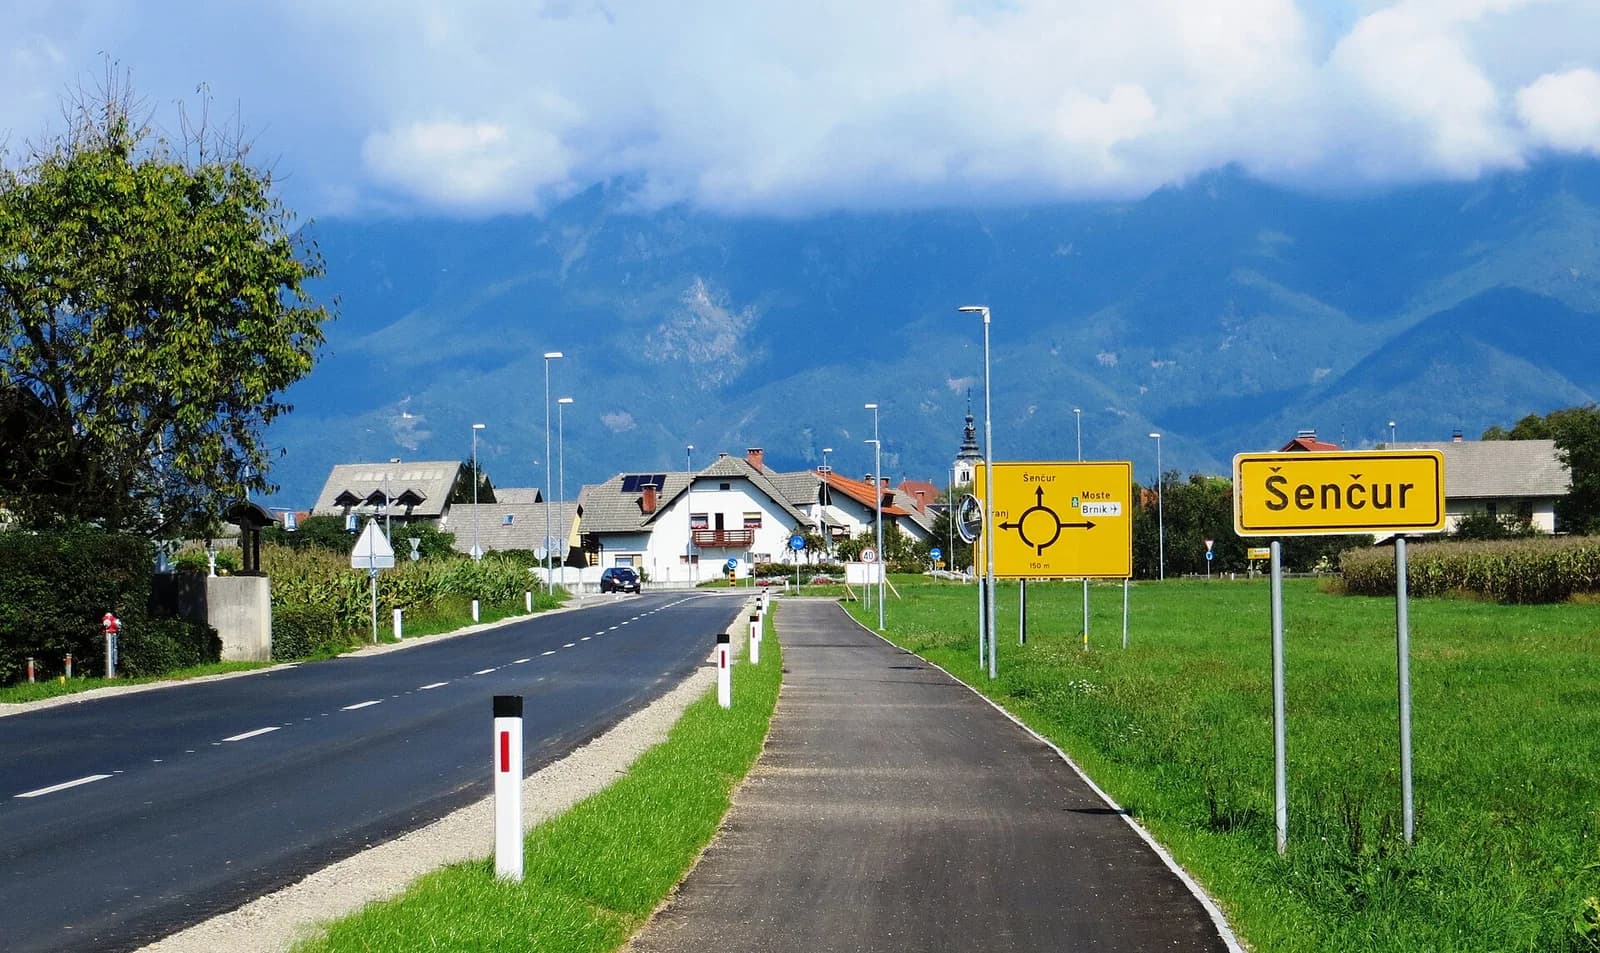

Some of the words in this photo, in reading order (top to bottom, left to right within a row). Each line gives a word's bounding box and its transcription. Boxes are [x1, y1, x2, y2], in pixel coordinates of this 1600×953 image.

[1023, 472, 1056, 482] Šenčur
[1265, 466, 1414, 511] Šenčur
[1082, 491, 1111, 500] Moste
[1082, 505, 1107, 514] Brnik
[863, 551, 874, 560] 40
